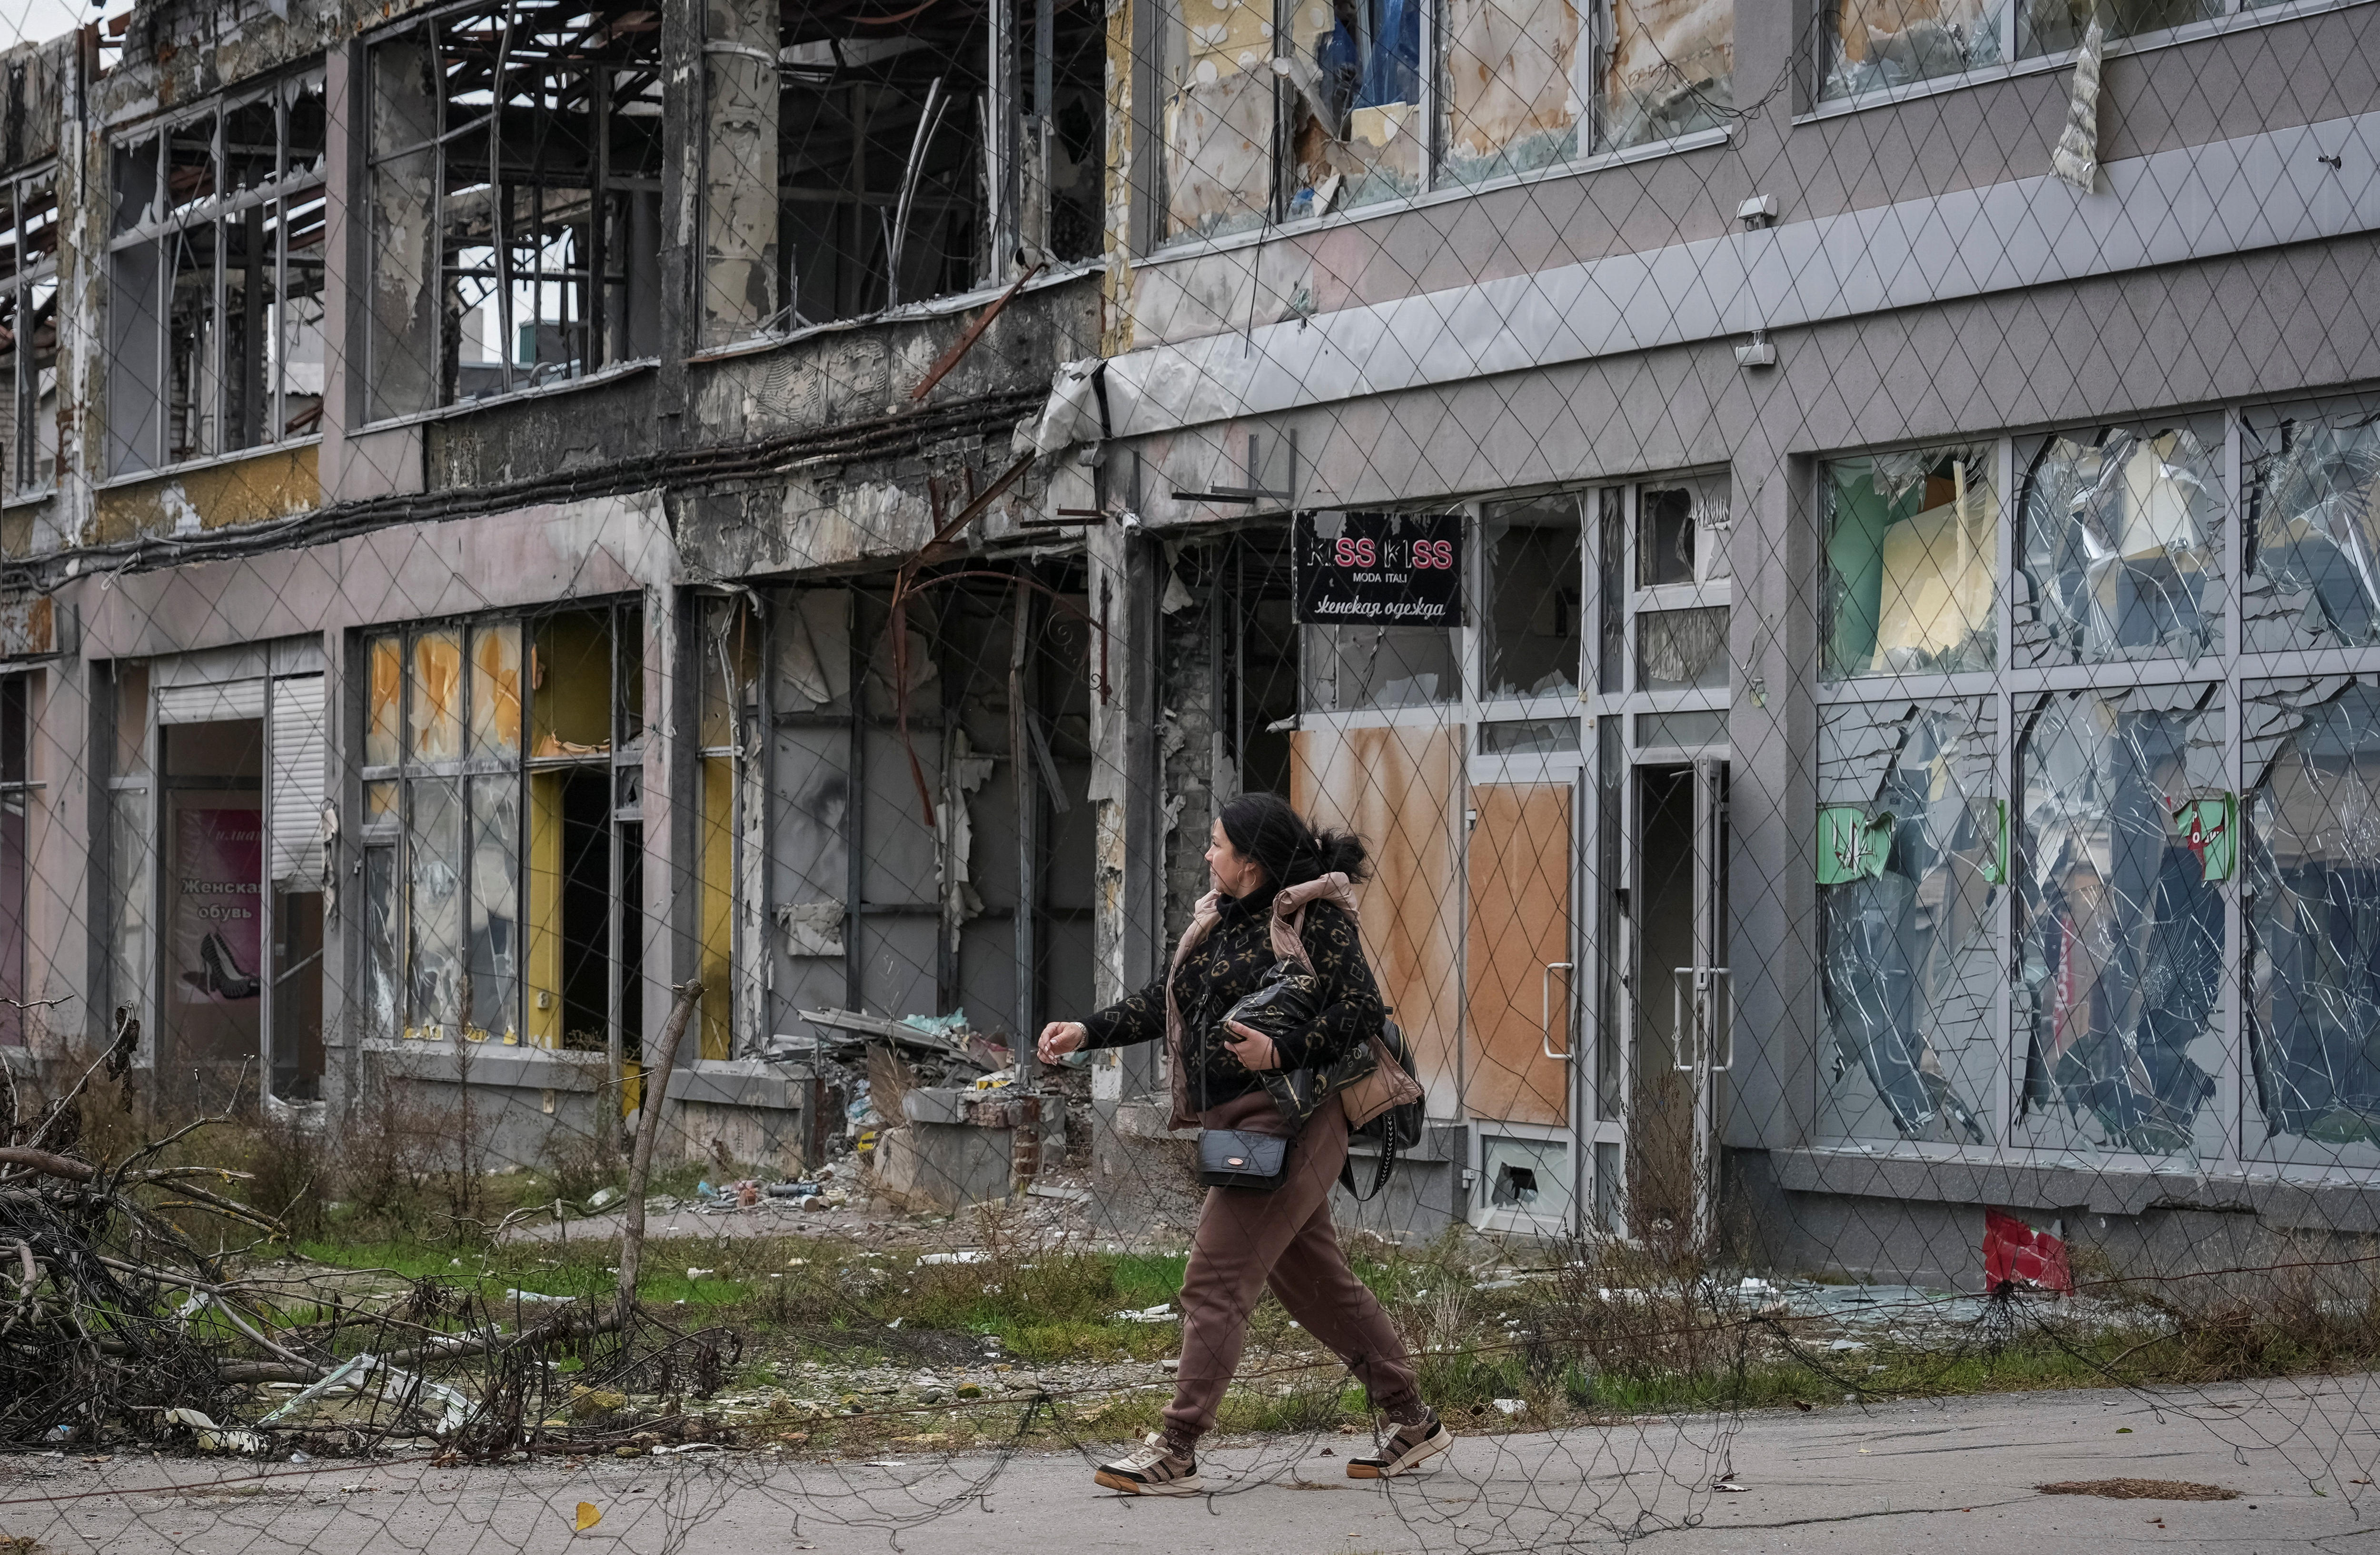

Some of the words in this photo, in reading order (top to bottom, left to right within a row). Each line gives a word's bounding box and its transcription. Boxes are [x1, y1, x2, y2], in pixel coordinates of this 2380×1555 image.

[1353, 573, 1381, 583] MODA
[1385, 573, 1407, 583] ITALI
[198, 903, 252, 922] обувь
